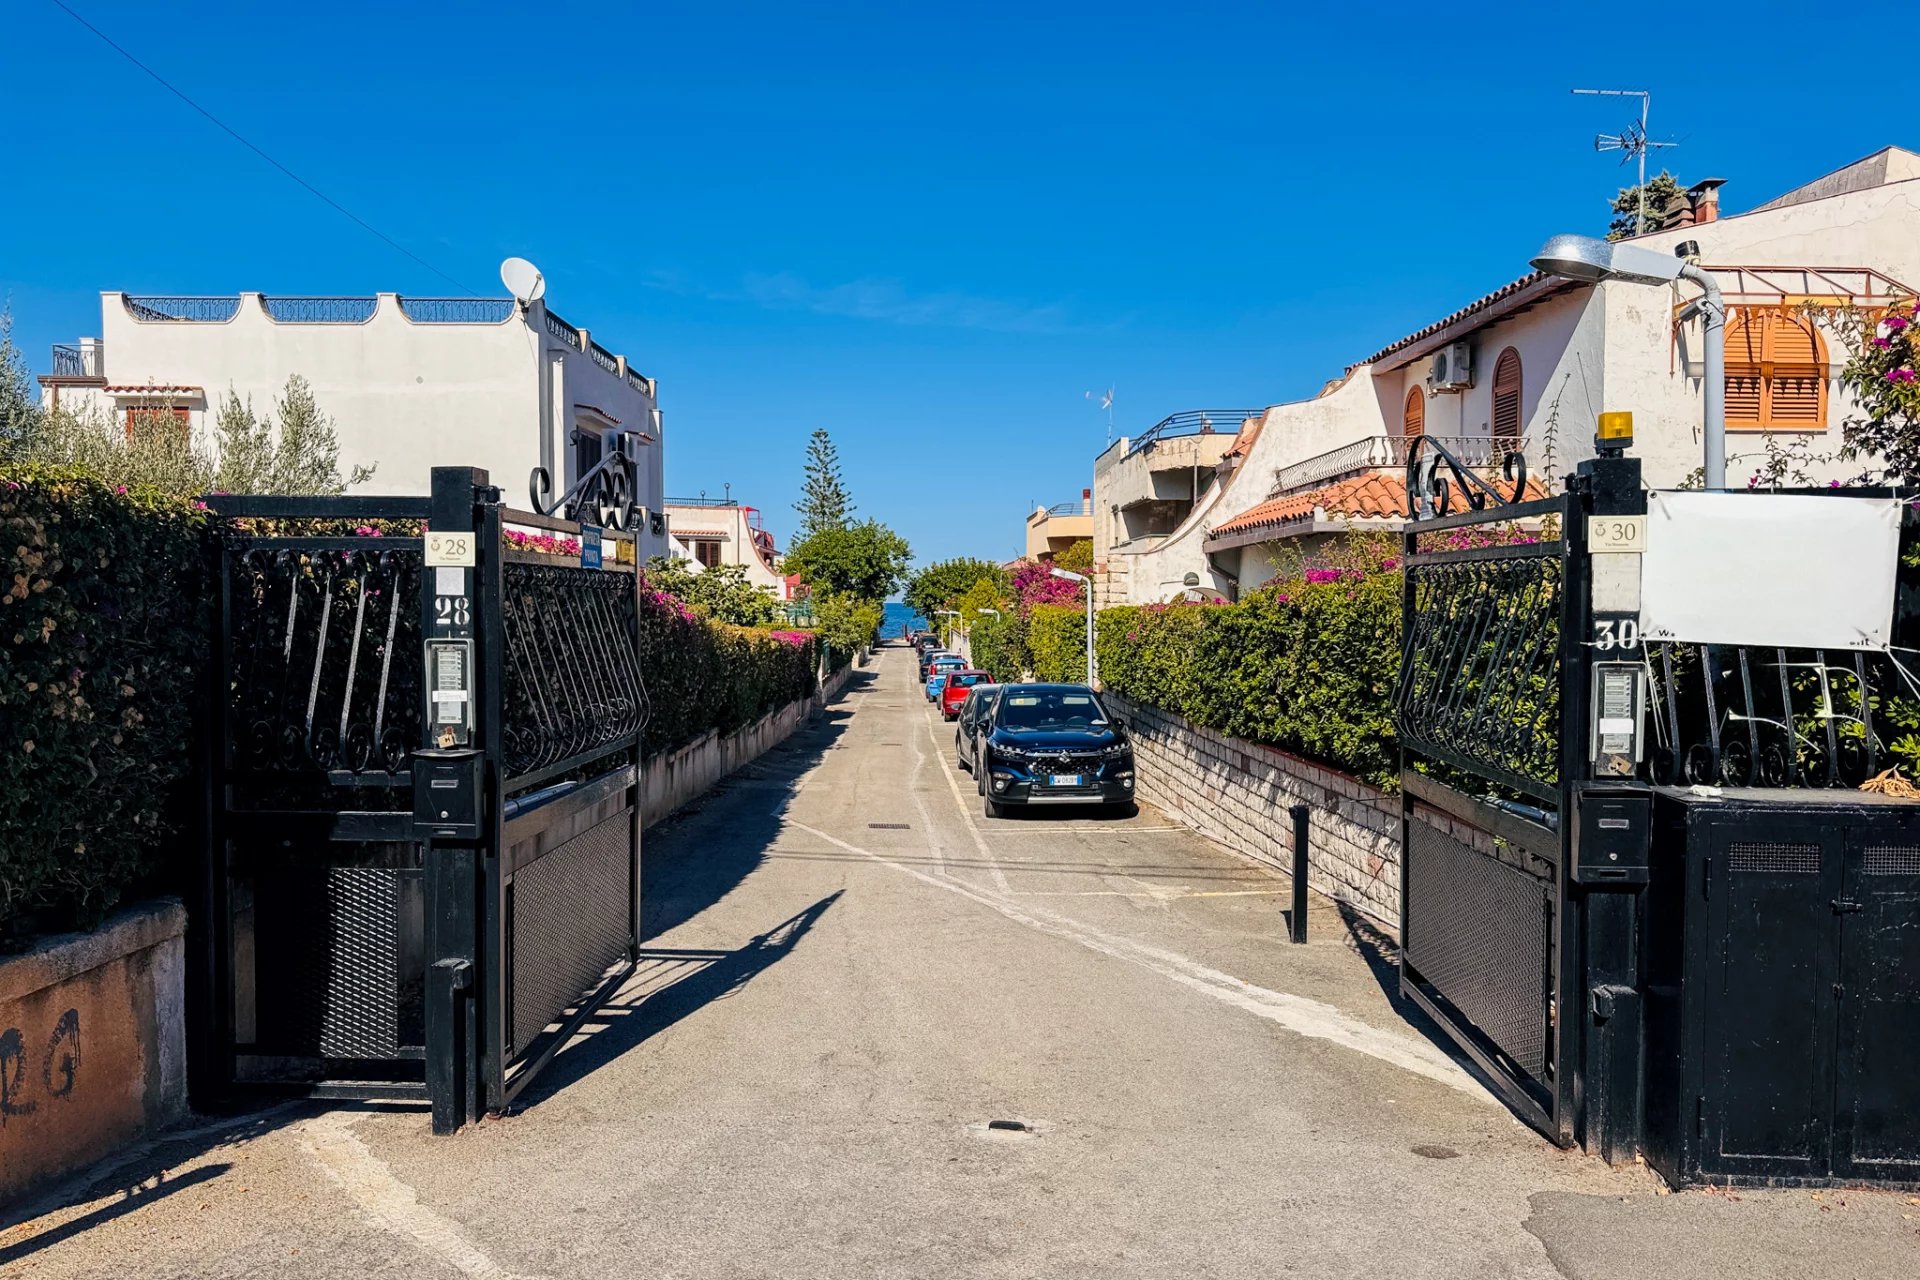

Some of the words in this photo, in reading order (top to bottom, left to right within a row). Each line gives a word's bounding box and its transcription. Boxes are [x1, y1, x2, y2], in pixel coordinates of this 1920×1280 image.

[1611, 523, 1636, 541] 30
[445, 539, 467, 556] 28
[434, 597, 470, 625] 28
[1594, 620, 1638, 651] 30
